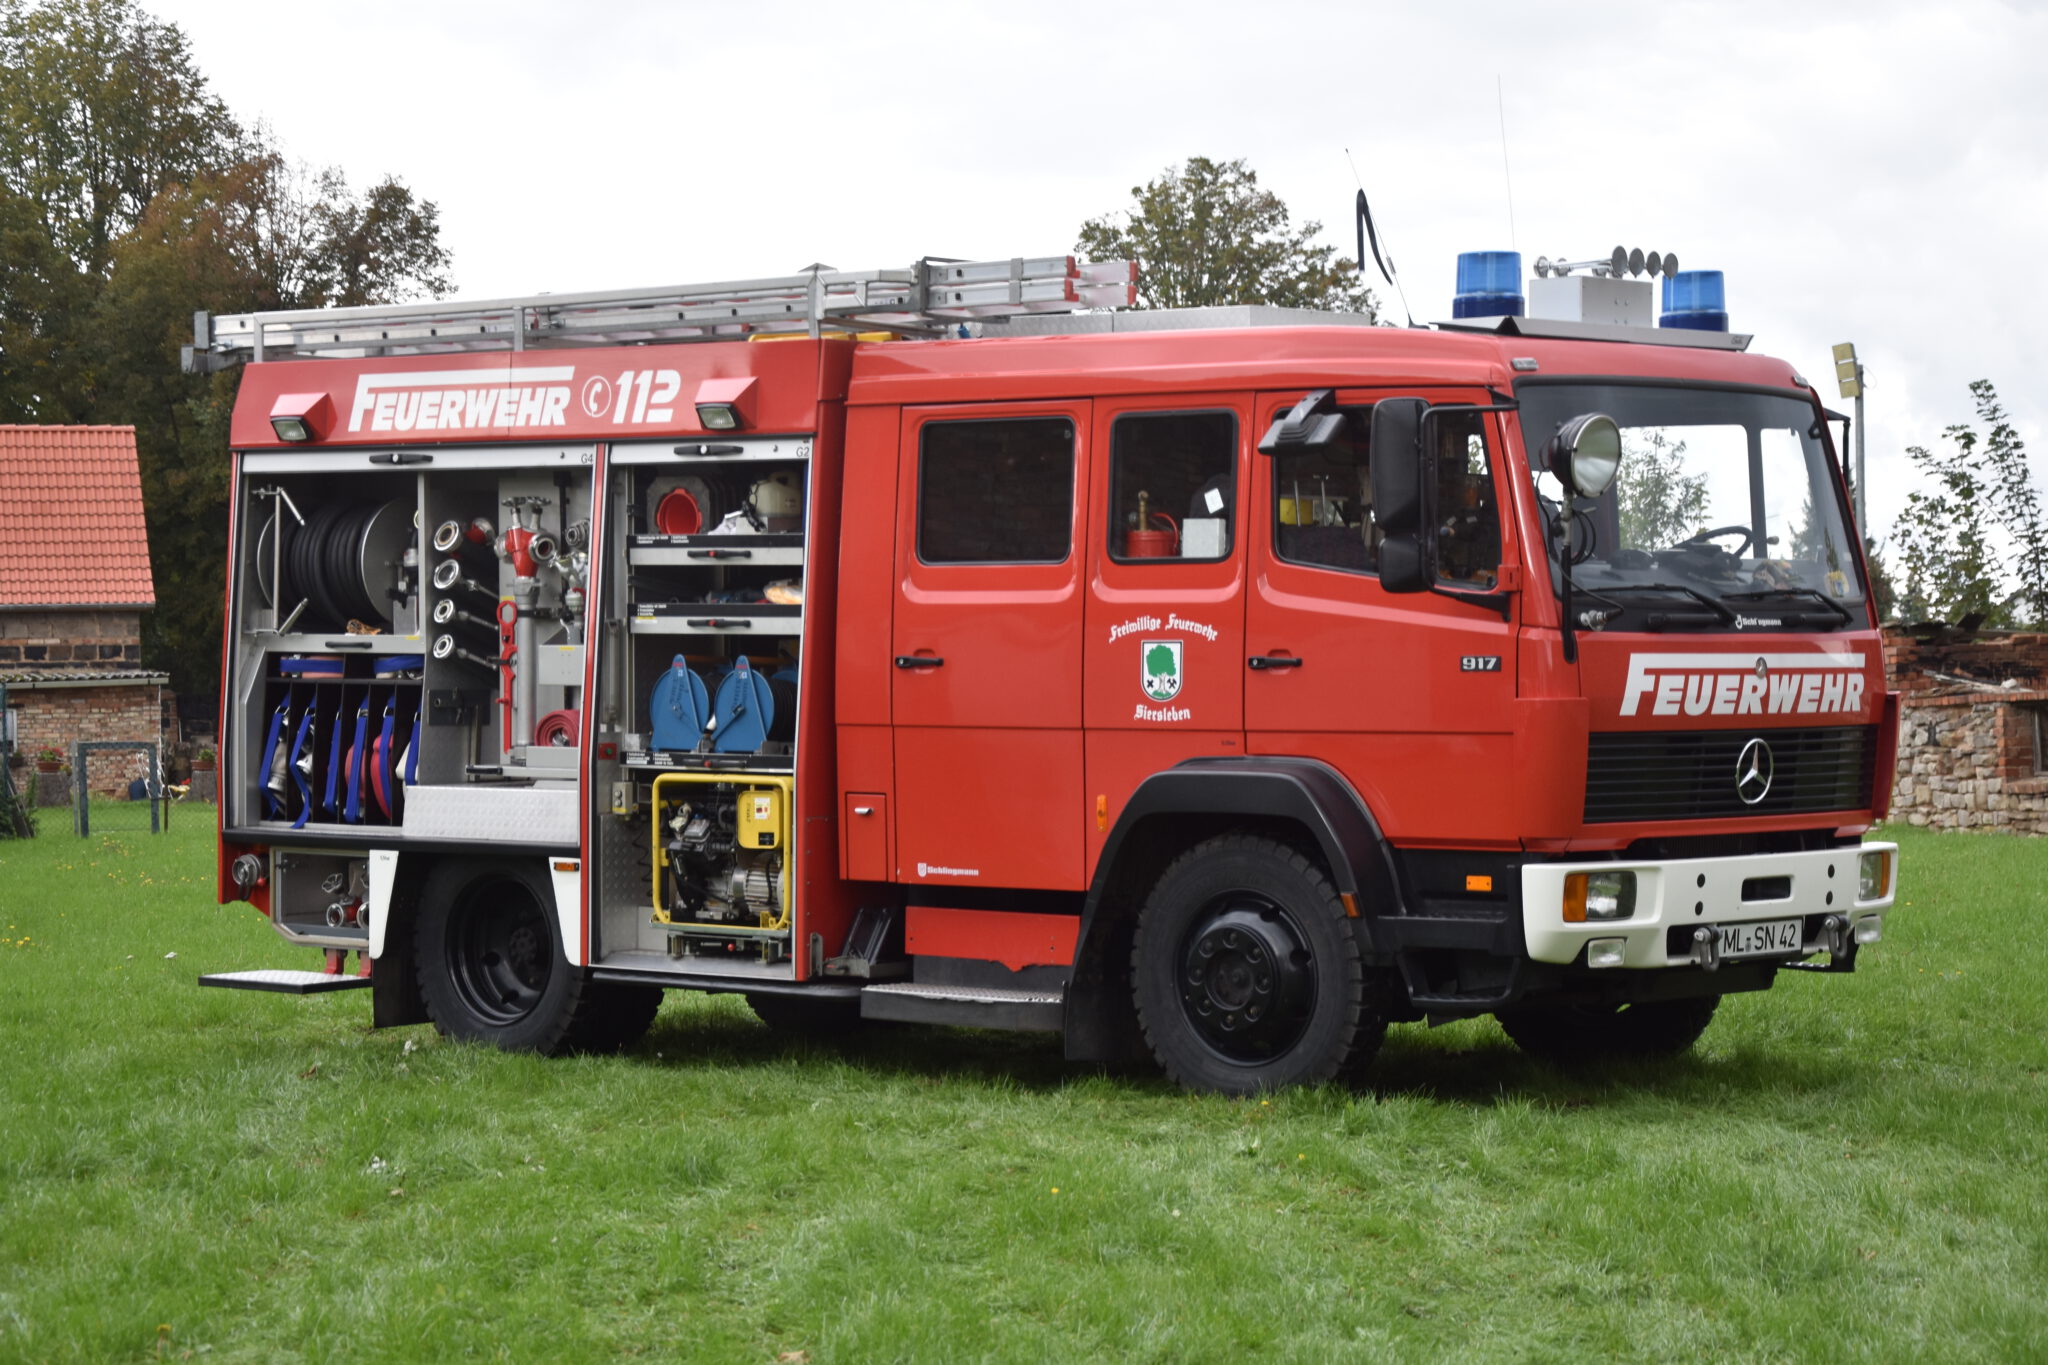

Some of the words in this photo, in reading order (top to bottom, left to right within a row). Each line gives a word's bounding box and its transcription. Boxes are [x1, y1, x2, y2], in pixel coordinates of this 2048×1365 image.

[348, 366, 576, 433] FEUERWEHR
[612, 369, 682, 425] 112
[796, 446, 810, 458] G2
[1108, 615, 1161, 644] Freiwillige
[1165, 613, 1218, 641] Feuerwehr
[1462, 657, 1497, 670] 917
[1619, 653, 1866, 717] FEUERWEHR
[1723, 928, 1744, 954] ML
[1754, 924, 1776, 951] SN
[1779, 923, 1797, 949] 42
